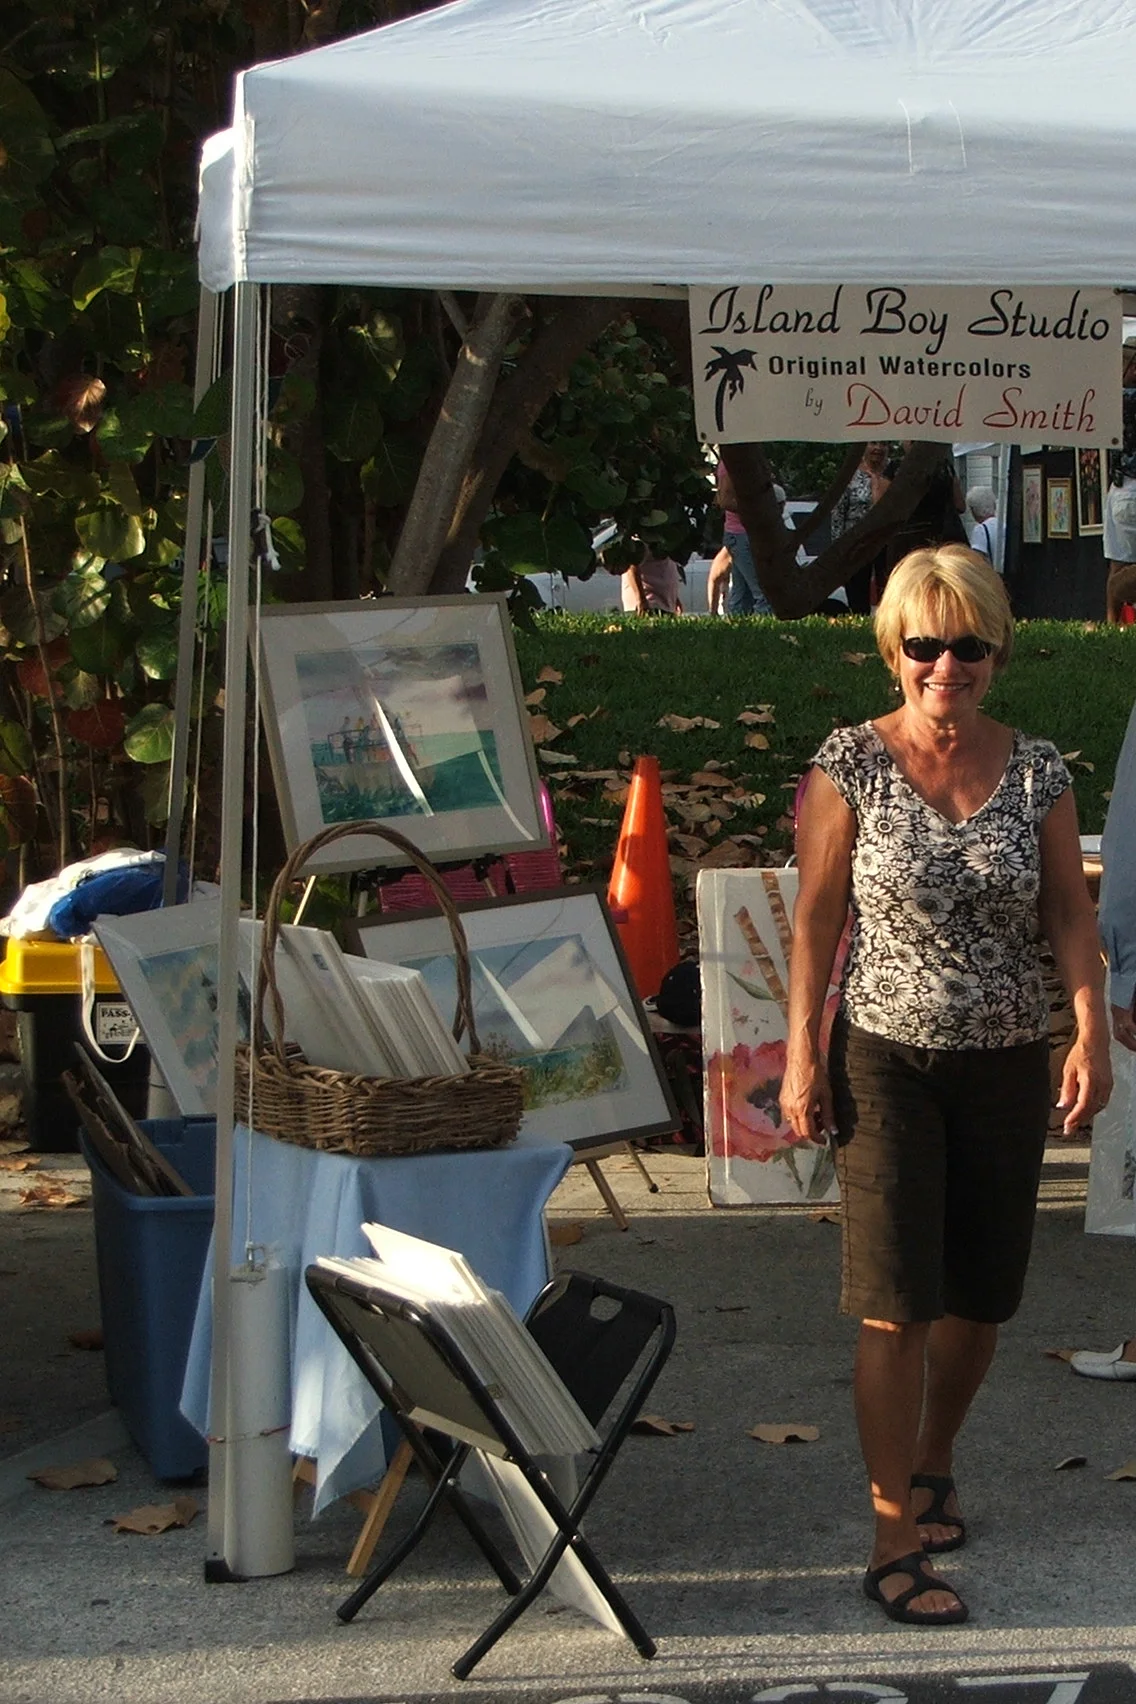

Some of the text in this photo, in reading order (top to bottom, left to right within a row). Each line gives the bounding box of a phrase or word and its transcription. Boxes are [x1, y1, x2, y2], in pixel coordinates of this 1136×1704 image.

[698, 284, 1110, 356] Island Boy Studio
[768, 355, 1032, 379] Original Watercolors
[804, 382, 1097, 433] by David Smith
